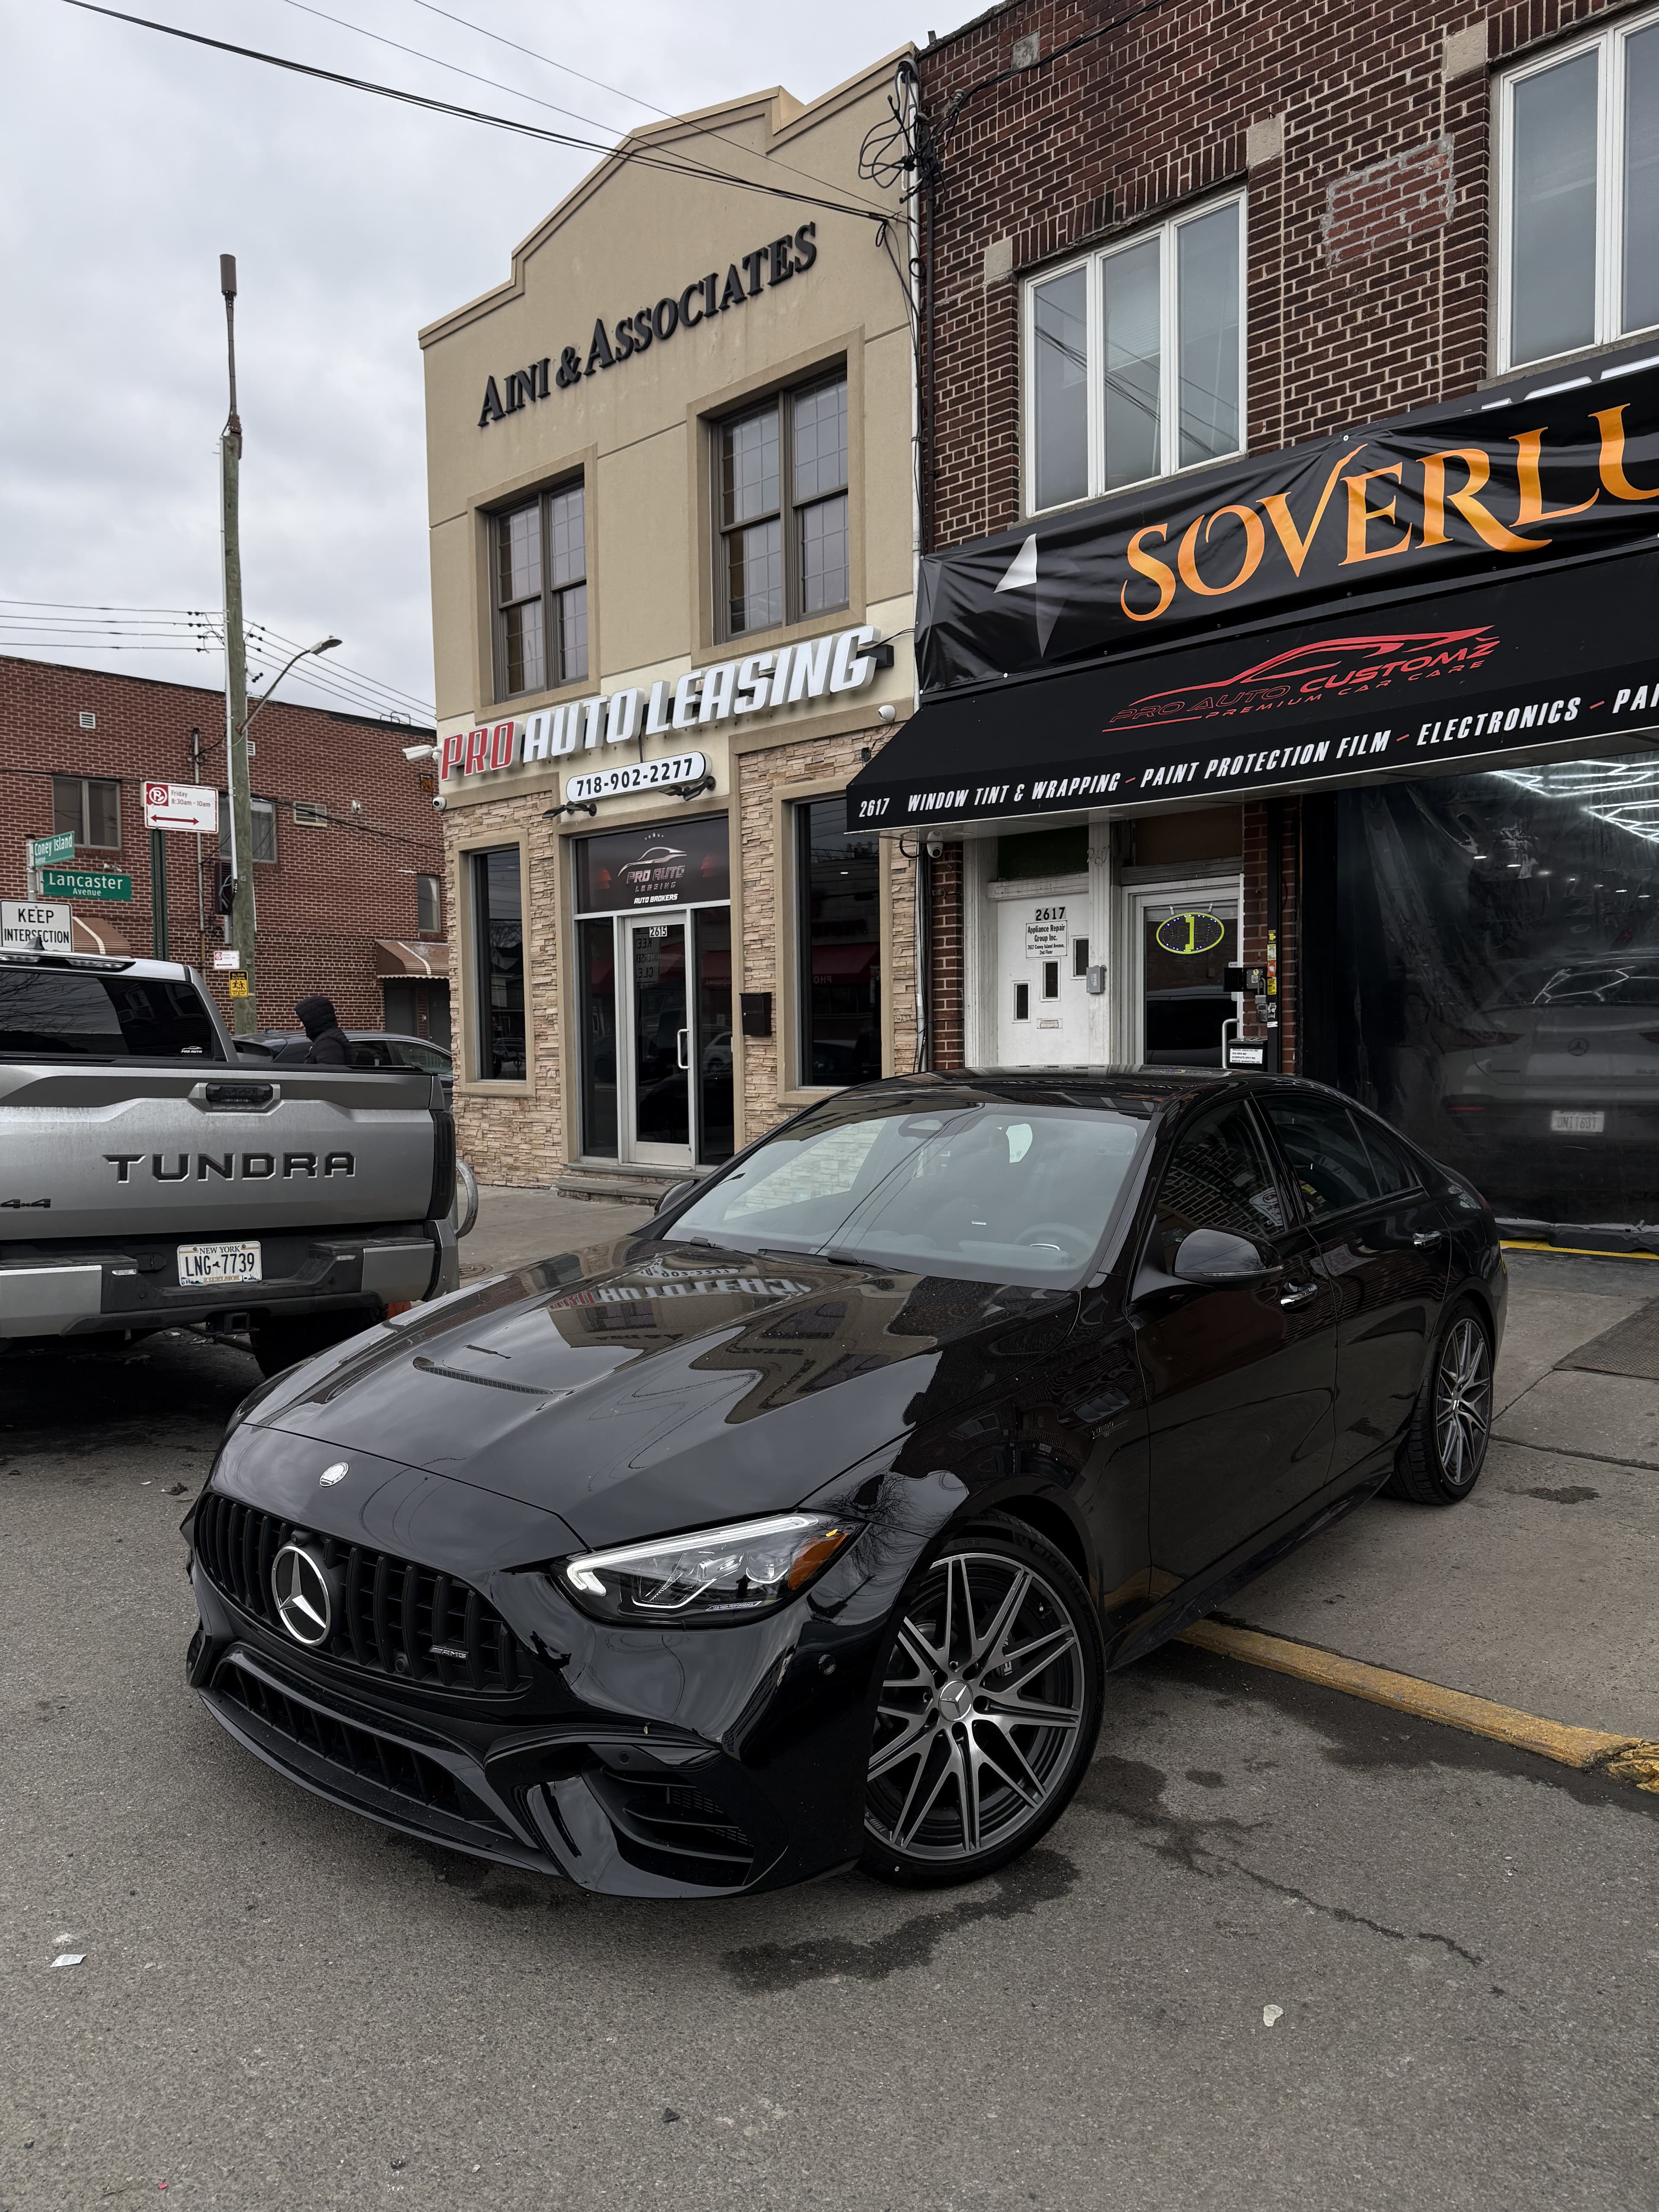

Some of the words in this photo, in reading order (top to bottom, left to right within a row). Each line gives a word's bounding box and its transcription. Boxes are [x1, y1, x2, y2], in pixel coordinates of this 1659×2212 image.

[555, 345, 582, 388] &
[1205, 695, 1323, 718] PREMIUM
[1338, 680, 1390, 696] CAR
[1409, 659, 1485, 681] CARE
[441, 719, 515, 782] PRO
[522, 687, 645, 763] AUTO
[646, 625, 881, 735] LEASING
[1109, 700, 1185, 723] PRO
[1186, 686, 1291, 712] AUTO
[858, 798, 890, 817] 2617
[908, 788, 969, 812] WINDOW
[973, 785, 1010, 806] TINT
[1014, 784, 1024, 801] &
[1032, 772, 1121, 800] WRAPPING
[1140, 761, 1200, 788] PAINT
[1204, 741, 1331, 779] PROTECTION
[1336, 730, 1392, 759] FILM
[1416, 697, 1582, 746] ELECTRONICS
[576, 758, 693, 797] 718-902-2277
[34, 842, 52, 856] Coney
[54, 833, 73, 852] Island
[49, 873, 123, 890] Lancaster
[626, 870, 651, 884] PRO
[652, 865, 686, 880] AUTO
[73, 888, 102, 896] Avenue
[635, 882, 676, 893] LEASING
[650, 893, 678, 903] BROKERS
[18, 908, 54, 924] KEEP
[1036, 907, 1065, 921] 2617
[650, 927, 667, 937] 2615
[1027, 925, 1049, 934] Appliance
[1050, 924, 1065, 932] Repair
[103, 1151, 356, 1183] TUNDRA
[185, 1255, 211, 1276] LNG
[221, 1252, 254, 1274] 7739
